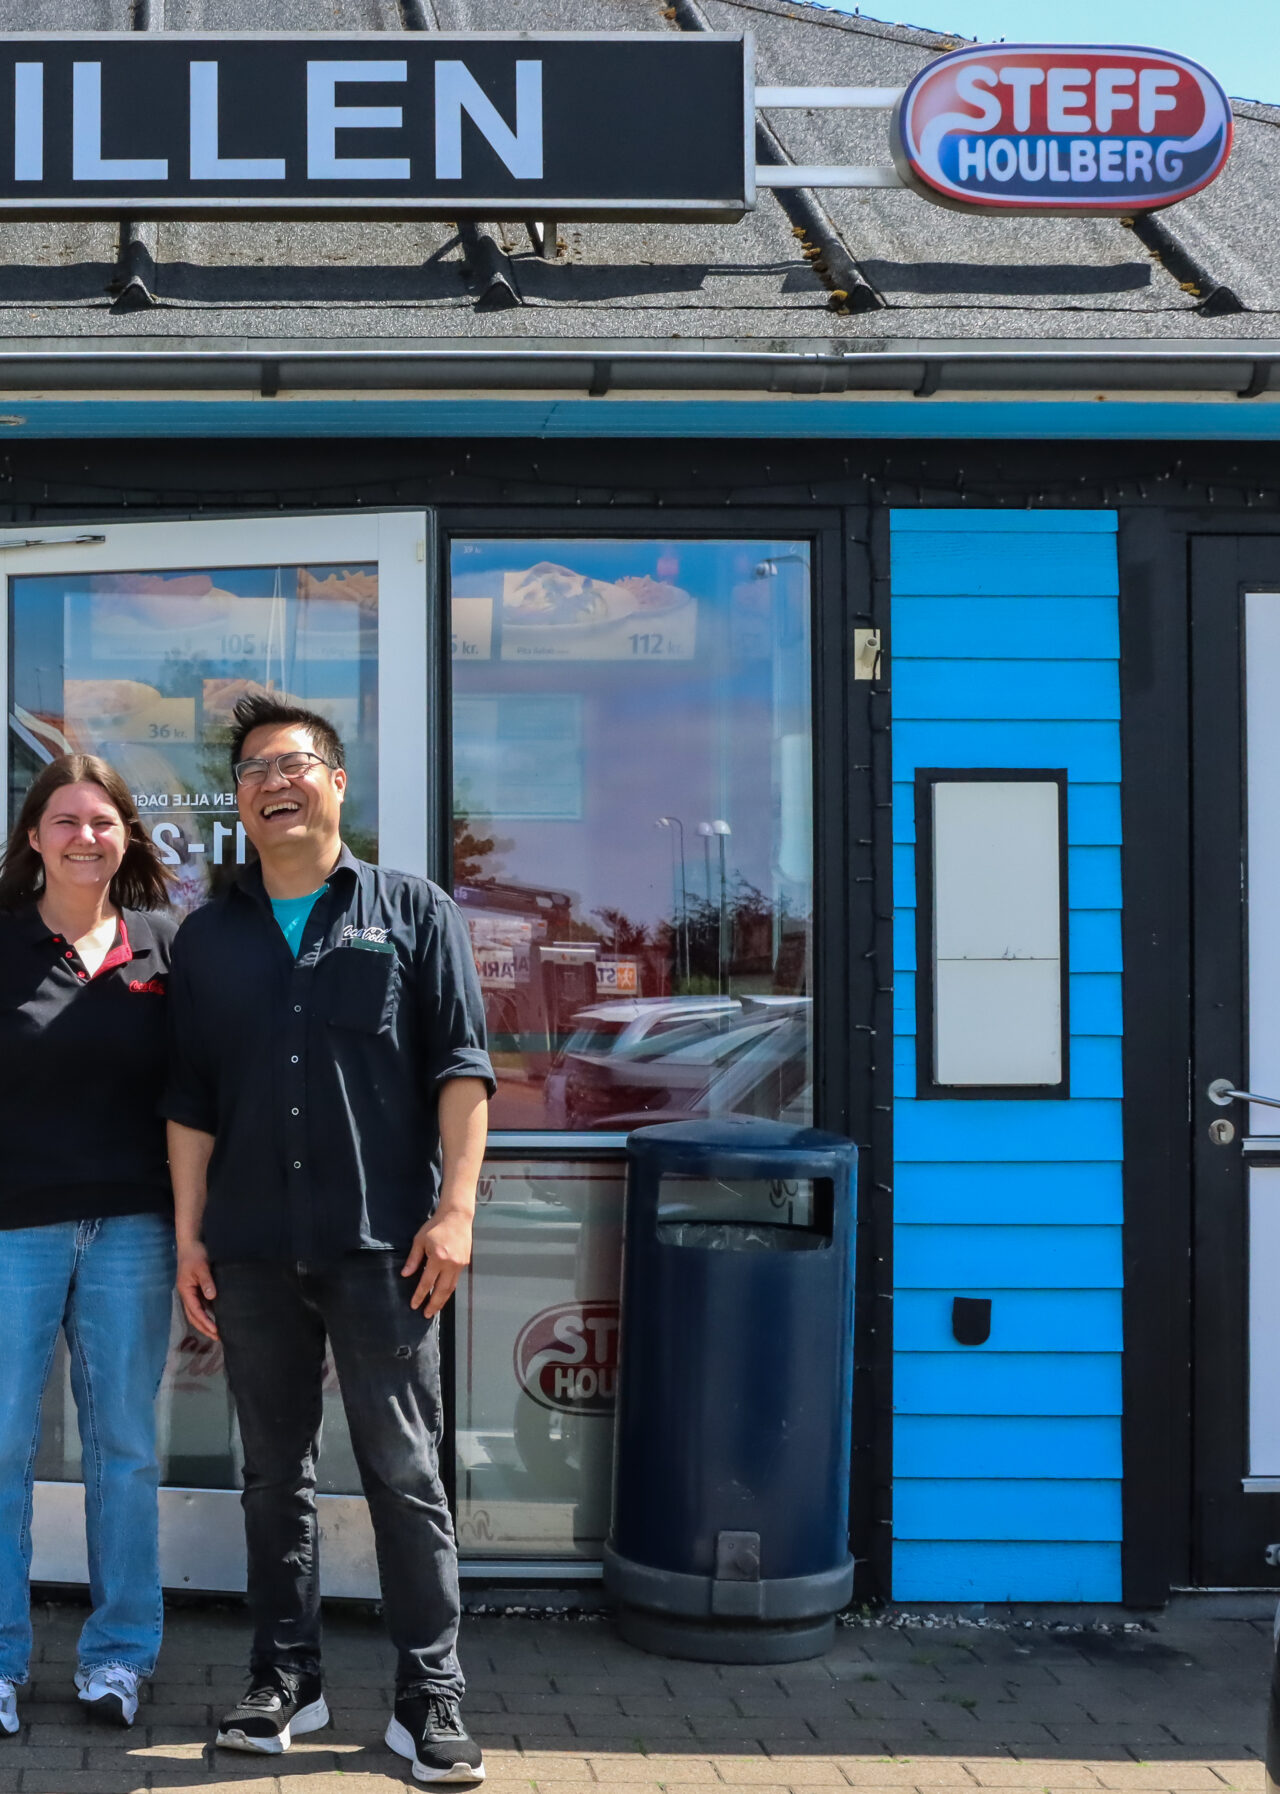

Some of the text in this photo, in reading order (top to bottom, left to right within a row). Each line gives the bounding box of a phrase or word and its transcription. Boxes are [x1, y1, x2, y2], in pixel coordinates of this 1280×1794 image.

[956, 65, 1180, 133] STEFF
[958, 138, 1183, 183] HOULBERG
[462, 641, 479, 655] kr.
[628, 633, 663, 655] 112
[148, 723, 188, 738] 36 kr.
